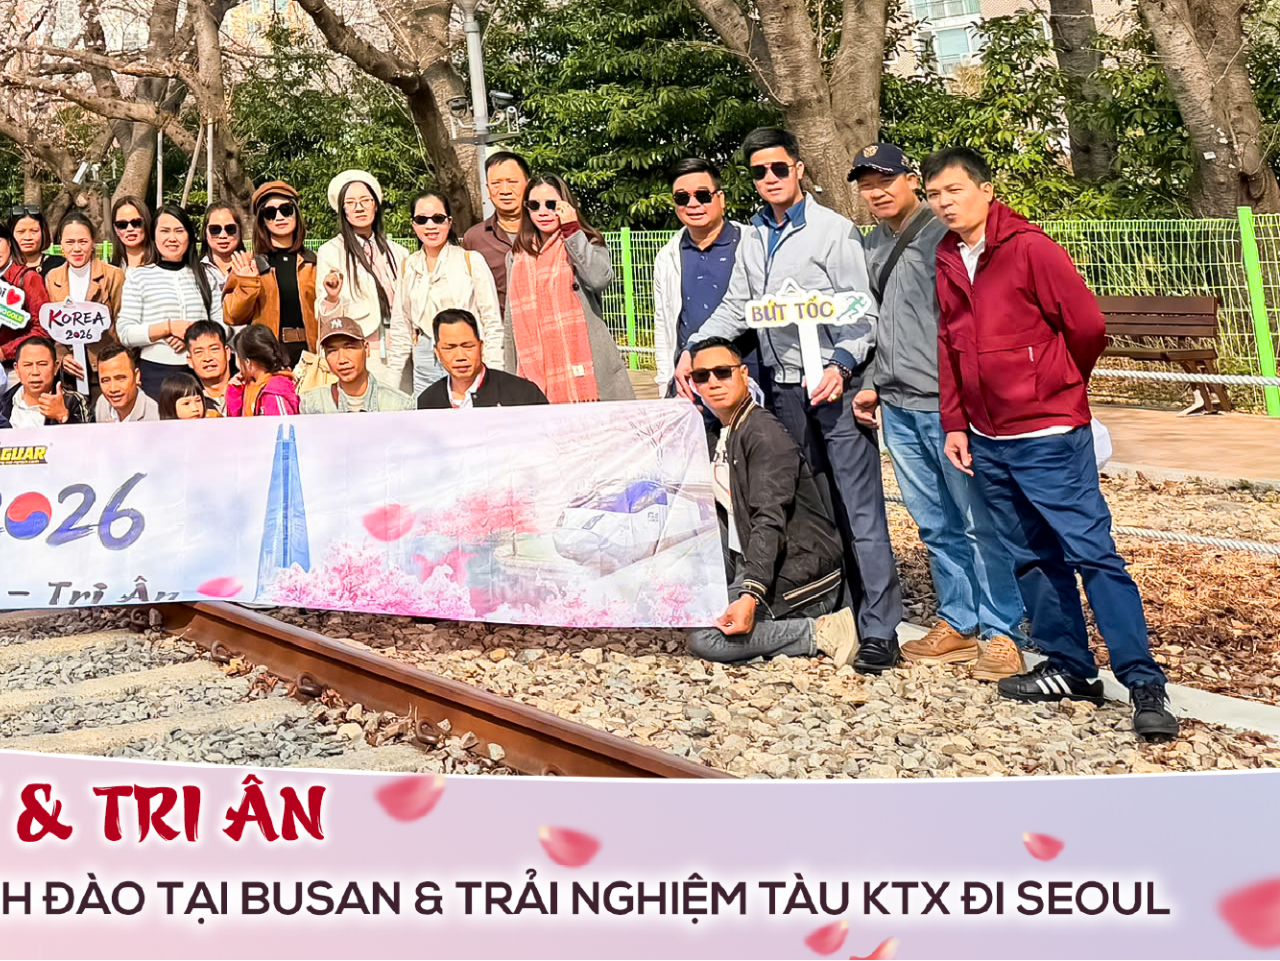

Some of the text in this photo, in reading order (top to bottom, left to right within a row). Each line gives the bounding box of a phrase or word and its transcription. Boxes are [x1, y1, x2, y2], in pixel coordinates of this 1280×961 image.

[49, 308, 106, 327] KOREA
[751, 295, 835, 322] BỨT TỐC
[65, 329, 93, 340] 2026
[48, 581, 108, 605] Tri
